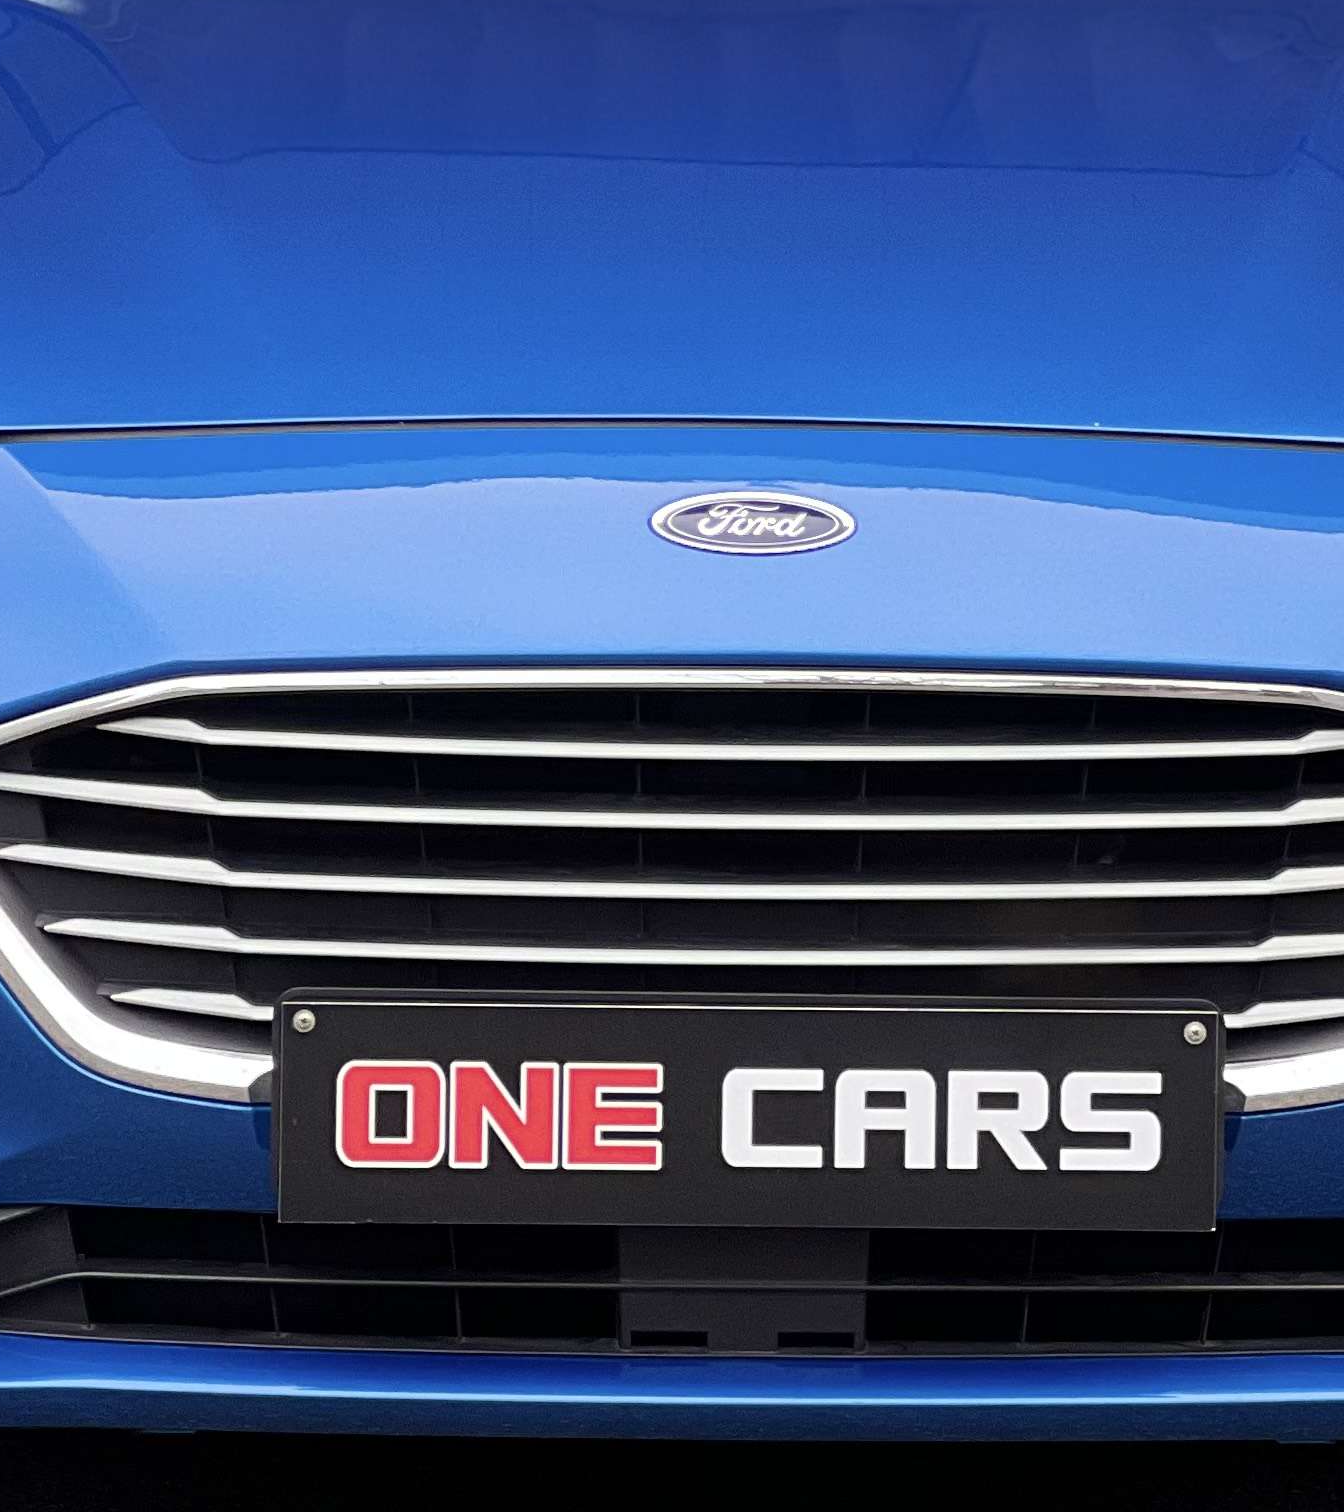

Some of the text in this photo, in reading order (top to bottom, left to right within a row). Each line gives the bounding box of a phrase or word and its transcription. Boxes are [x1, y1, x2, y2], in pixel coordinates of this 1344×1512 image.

[697, 502, 807, 537] Ford
[336, 1059, 1163, 1172] ONE CARS
